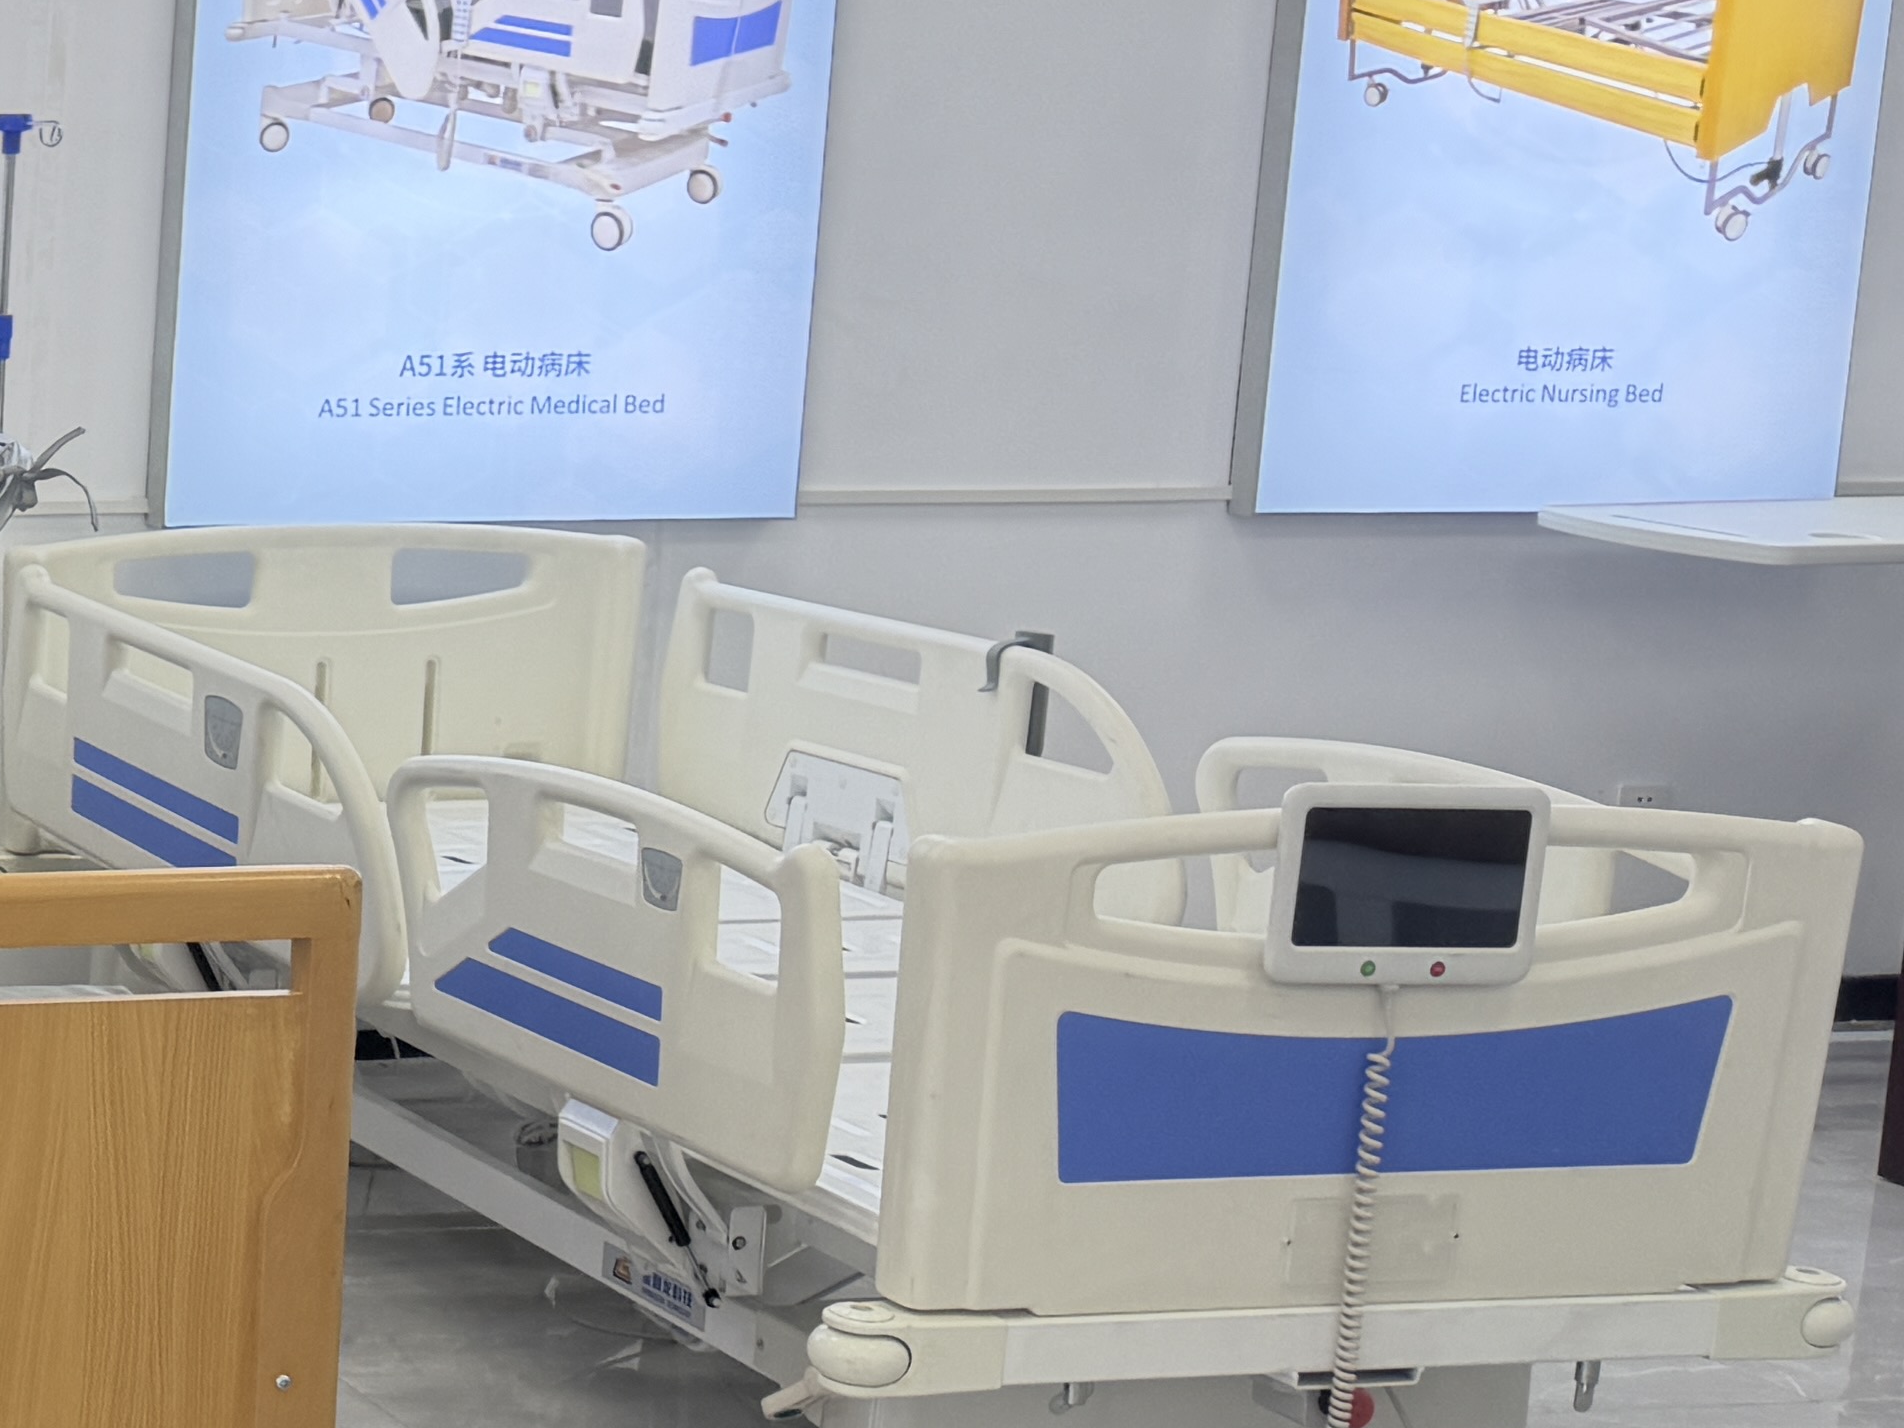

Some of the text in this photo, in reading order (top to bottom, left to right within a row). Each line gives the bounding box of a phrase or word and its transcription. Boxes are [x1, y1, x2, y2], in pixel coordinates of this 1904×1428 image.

[398, 349, 592, 379] A51系 电动病床
[1516, 345, 1617, 373] 电动病床
[318, 393, 666, 418] A51 Series Electric Medical Bed
[1459, 382, 1664, 409] Electric Nursing Bed
